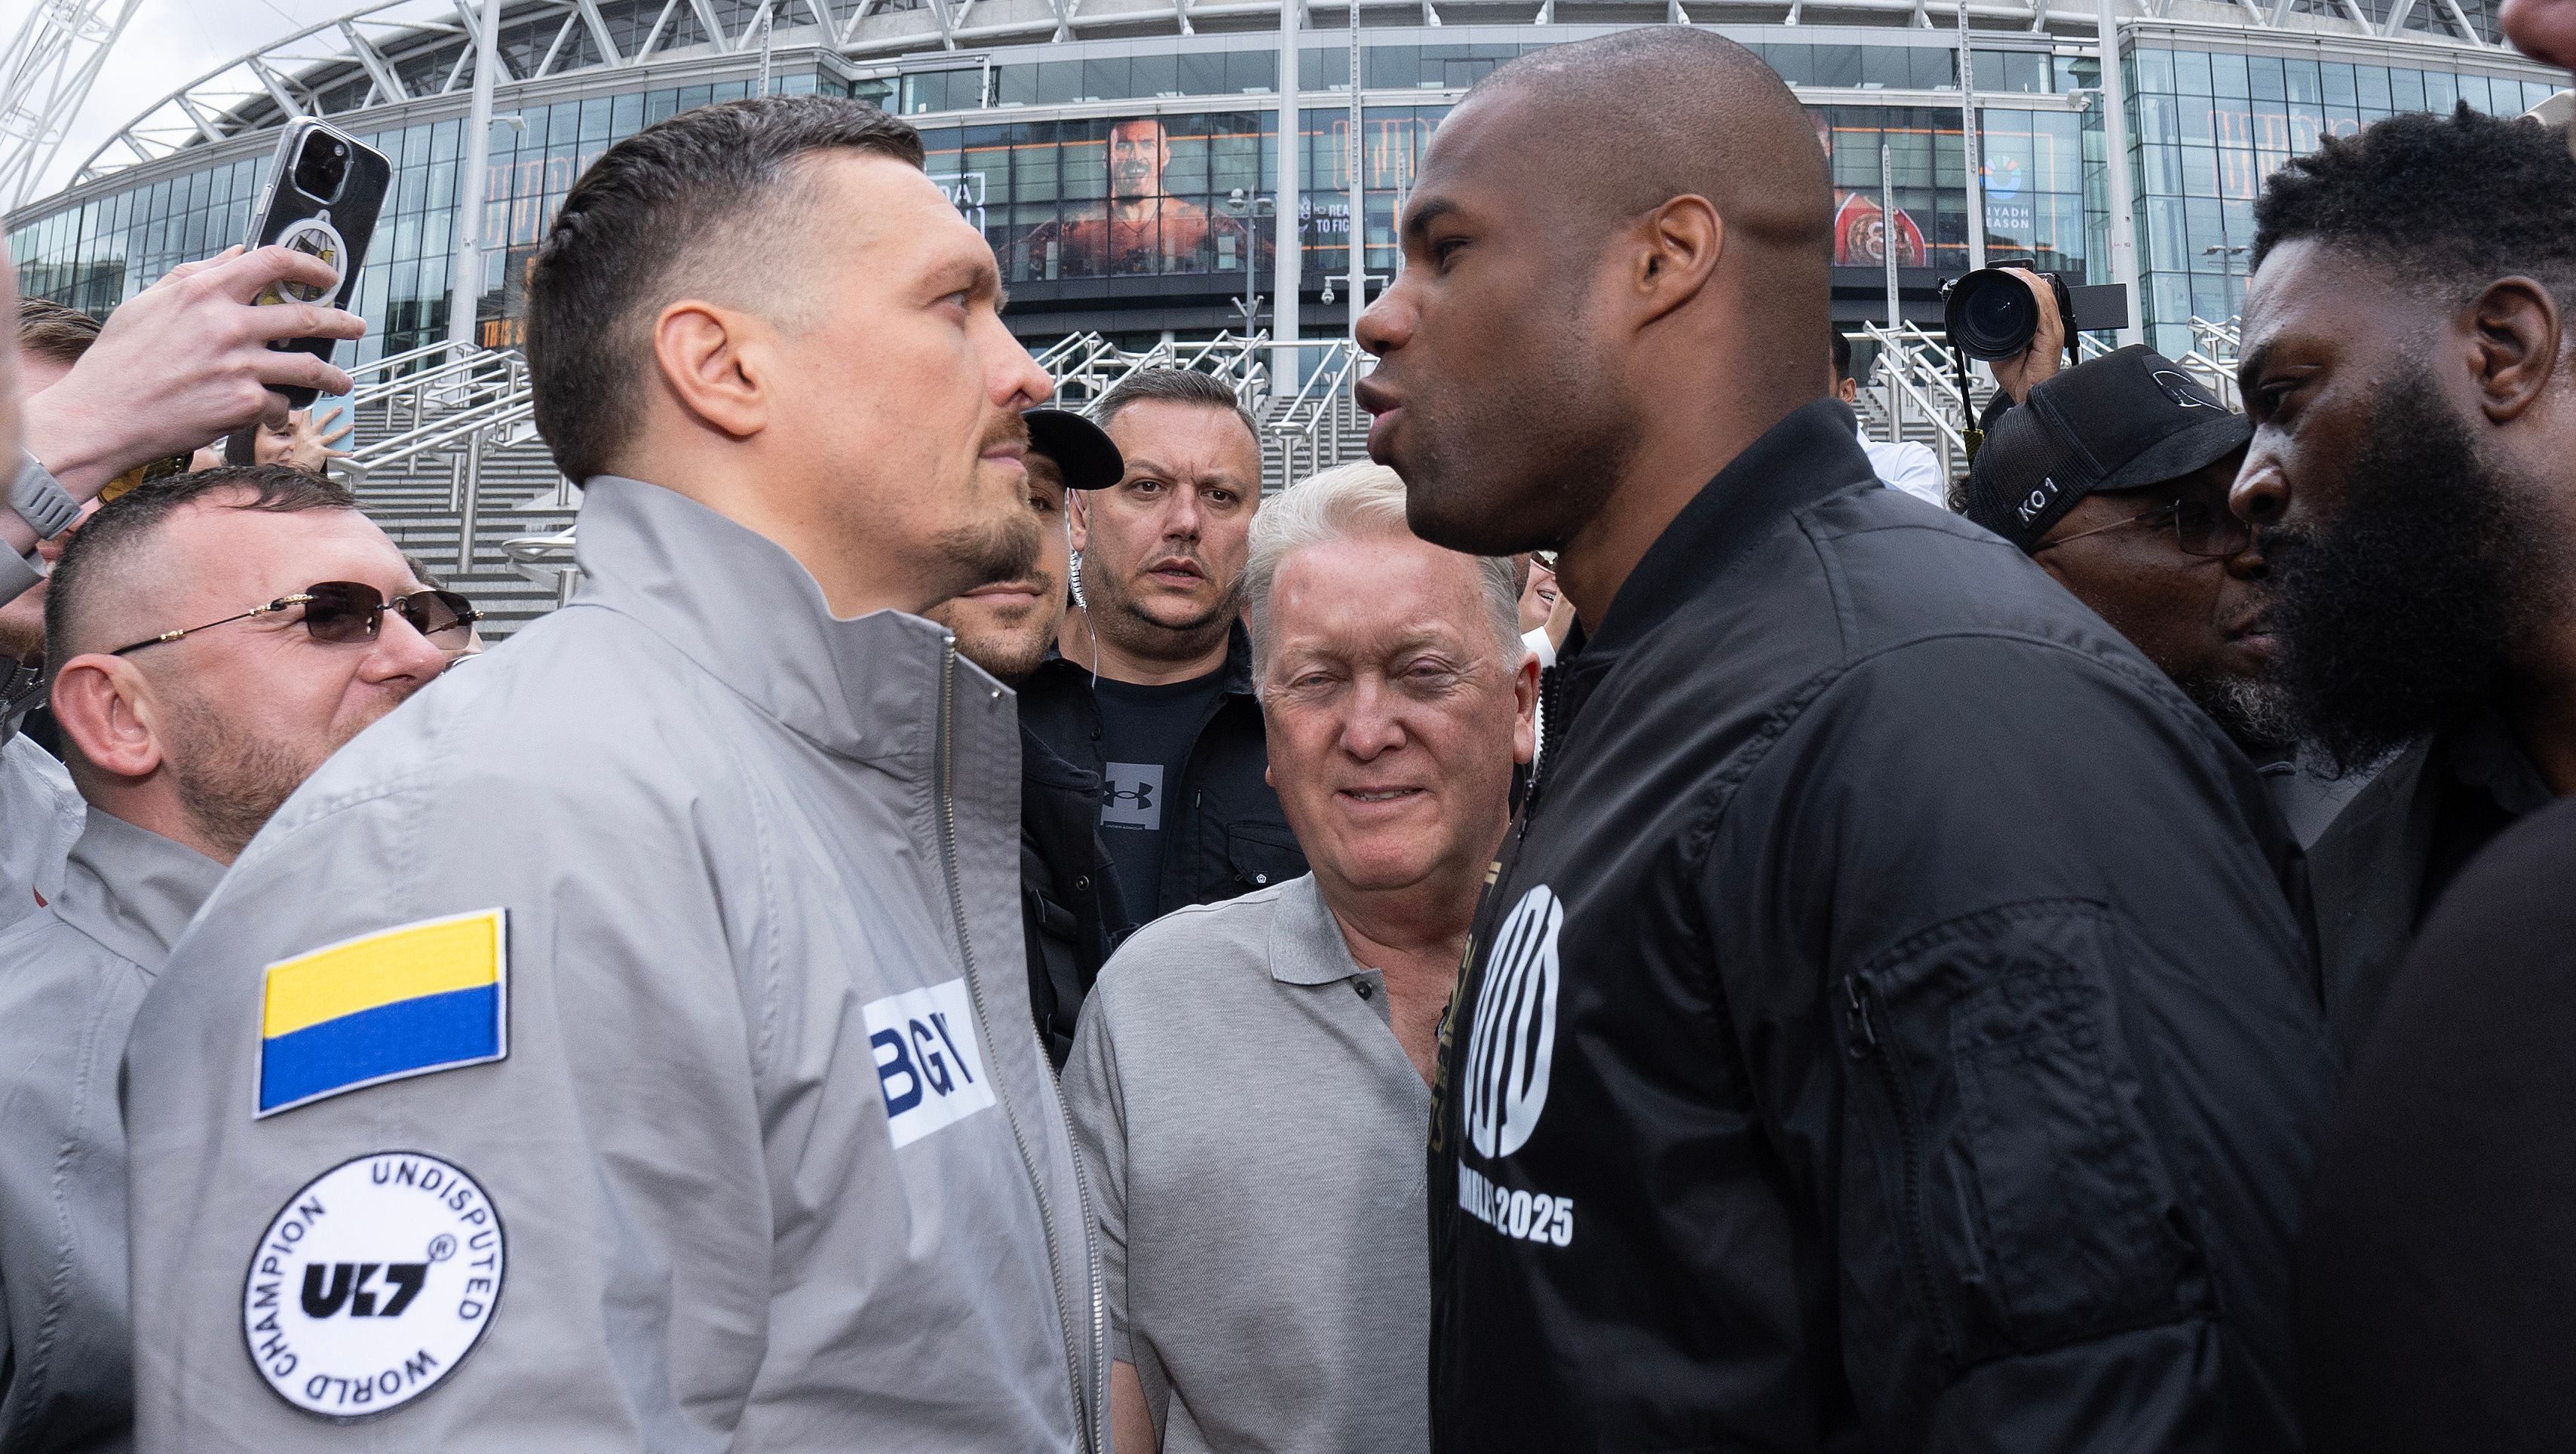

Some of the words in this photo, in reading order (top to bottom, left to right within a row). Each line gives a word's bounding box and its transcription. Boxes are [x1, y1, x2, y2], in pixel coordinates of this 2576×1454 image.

[1316, 219, 1330, 233] TO
[1332, 218, 1350, 233] FIG
[1986, 207, 2029, 217] IYADH
[1986, 218, 2029, 229] EASON
[2018, 490, 2045, 522] KO
[2045, 477, 2058, 492] 1
[372, 1161, 495, 1321] UNDISPUTED
[1495, 1186, 1574, 1247] 2025
[253, 1195, 327, 1377] CHAMPION
[305, 1349, 440, 1405] WORLD
